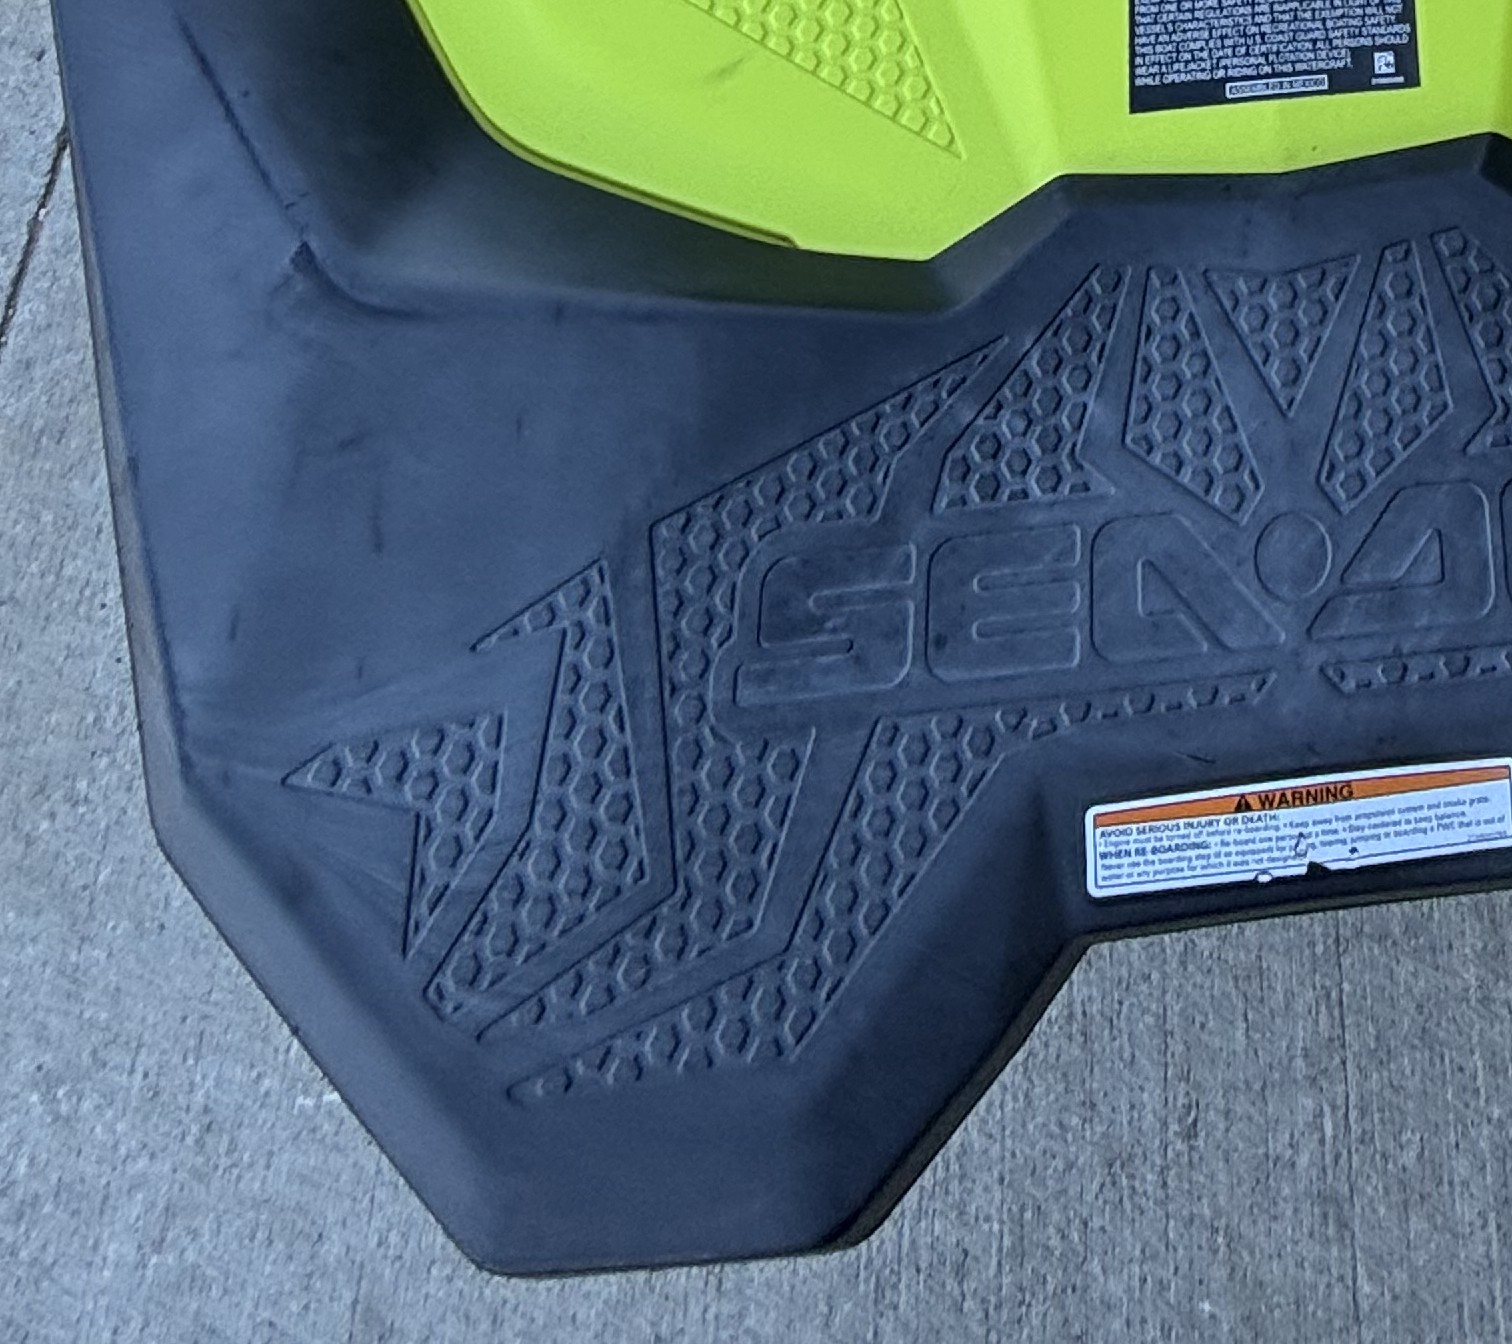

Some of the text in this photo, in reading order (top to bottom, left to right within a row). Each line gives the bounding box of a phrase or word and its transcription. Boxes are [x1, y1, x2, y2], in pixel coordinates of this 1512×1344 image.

[1258, 783, 1353, 809] WARNING
[1099, 826, 1132, 839] AVOID
[1135, 821, 1180, 835] SERIOUS
[1183, 817, 1220, 829] INJURY
[1223, 816, 1238, 825] OR
[1098, 847, 1131, 860] WHEN
